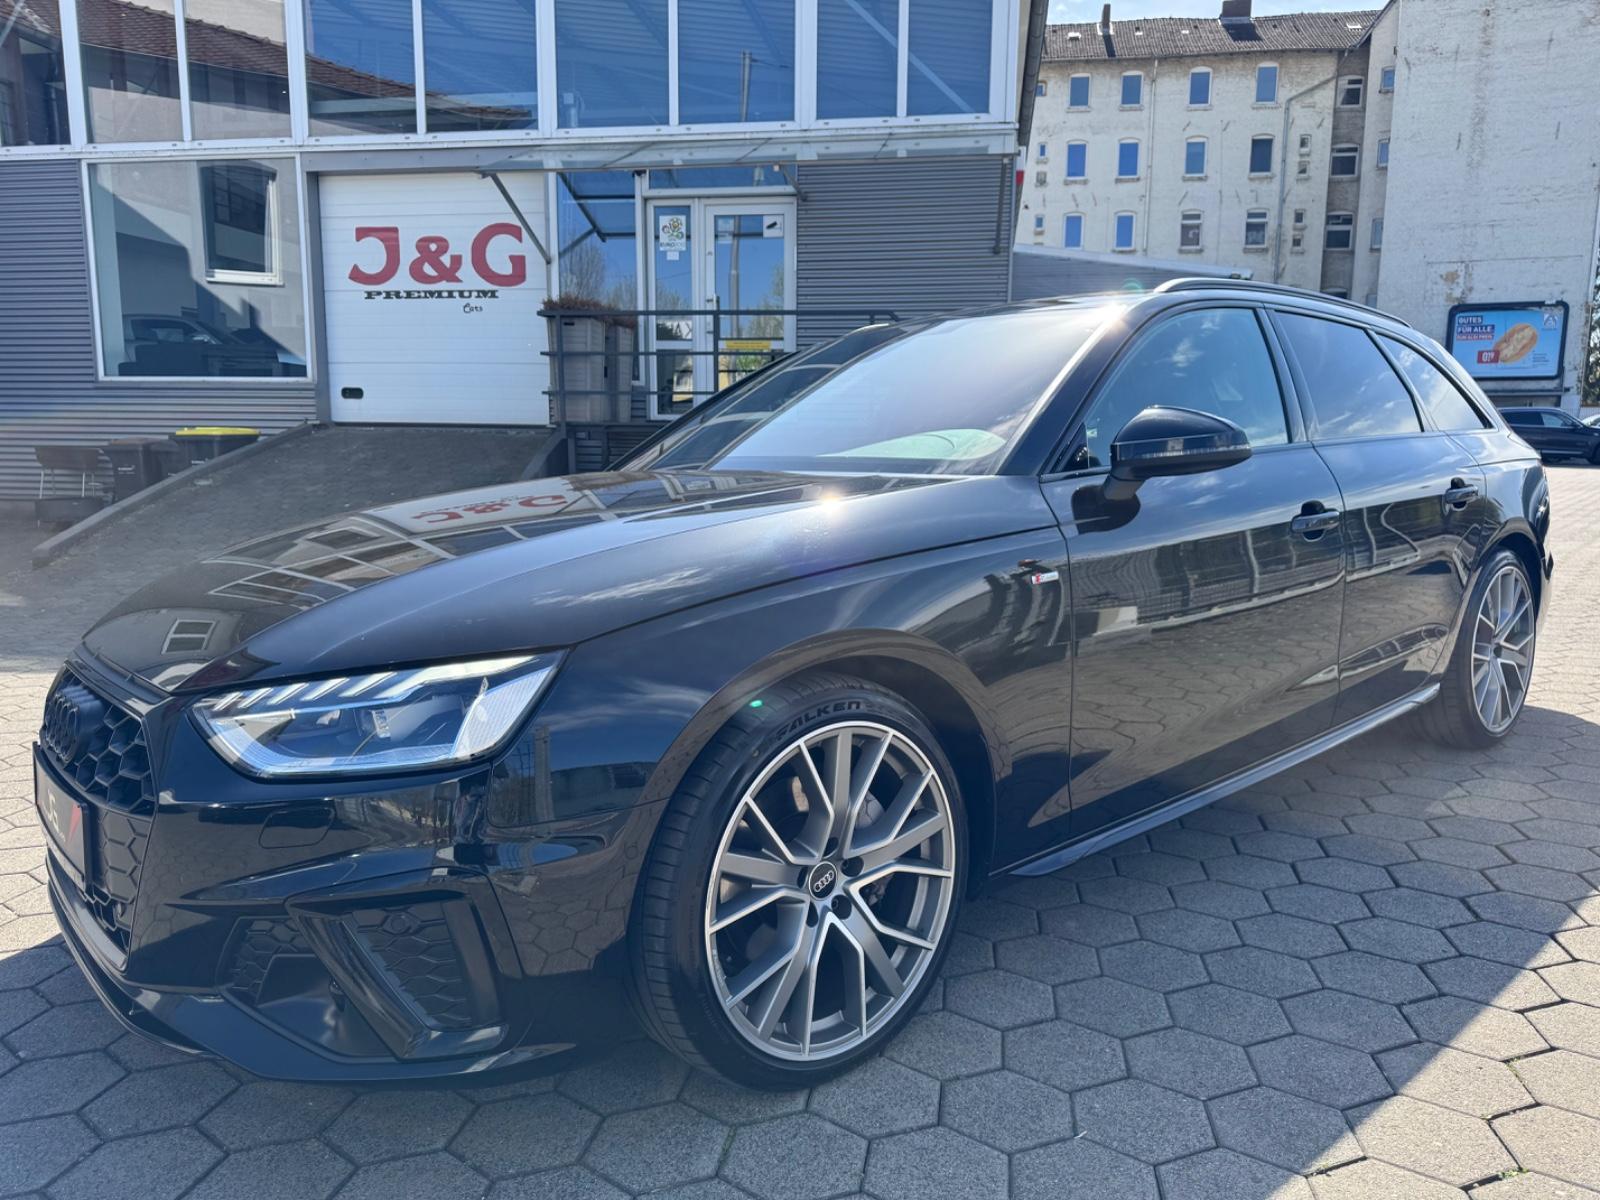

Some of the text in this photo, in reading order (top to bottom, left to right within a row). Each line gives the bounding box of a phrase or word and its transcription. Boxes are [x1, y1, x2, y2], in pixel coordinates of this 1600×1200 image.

[348, 222, 527, 288] J&G
[364, 289, 499, 300] PREMIUM
[776, 701, 862, 738] FALKEN
